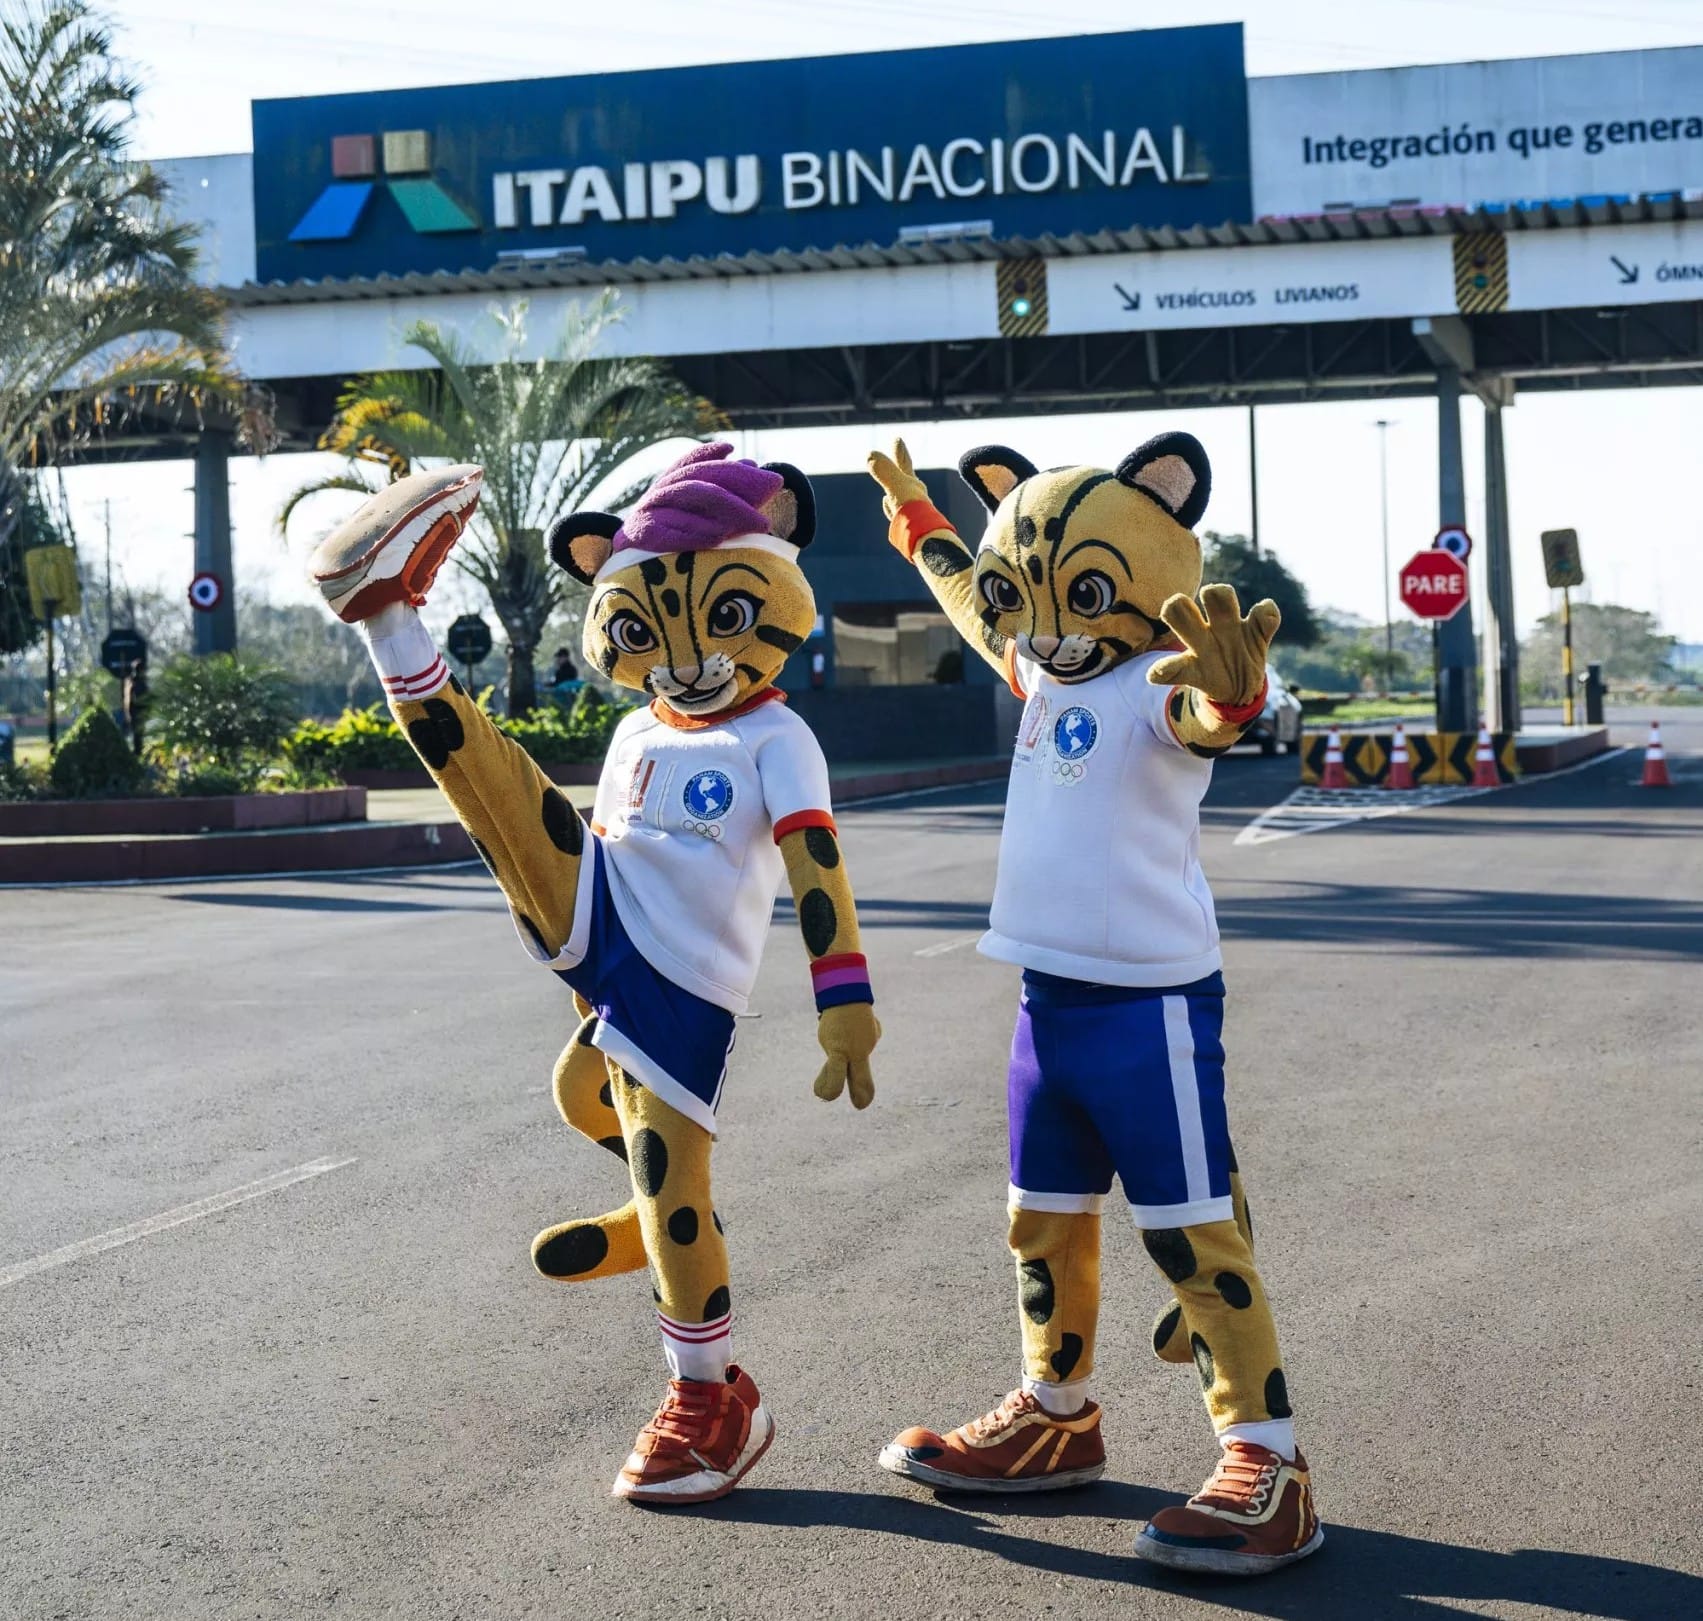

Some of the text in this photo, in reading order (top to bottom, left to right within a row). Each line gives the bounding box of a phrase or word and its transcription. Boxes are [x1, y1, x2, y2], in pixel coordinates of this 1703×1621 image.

[1303, 115, 1703, 168] Integración que genera
[493, 125, 1209, 228] ITAIPU BINACIONAL
[1156, 283, 1360, 310] VEHÍCULOS LIVIANOS
[1404, 573, 1463, 595] PARE
